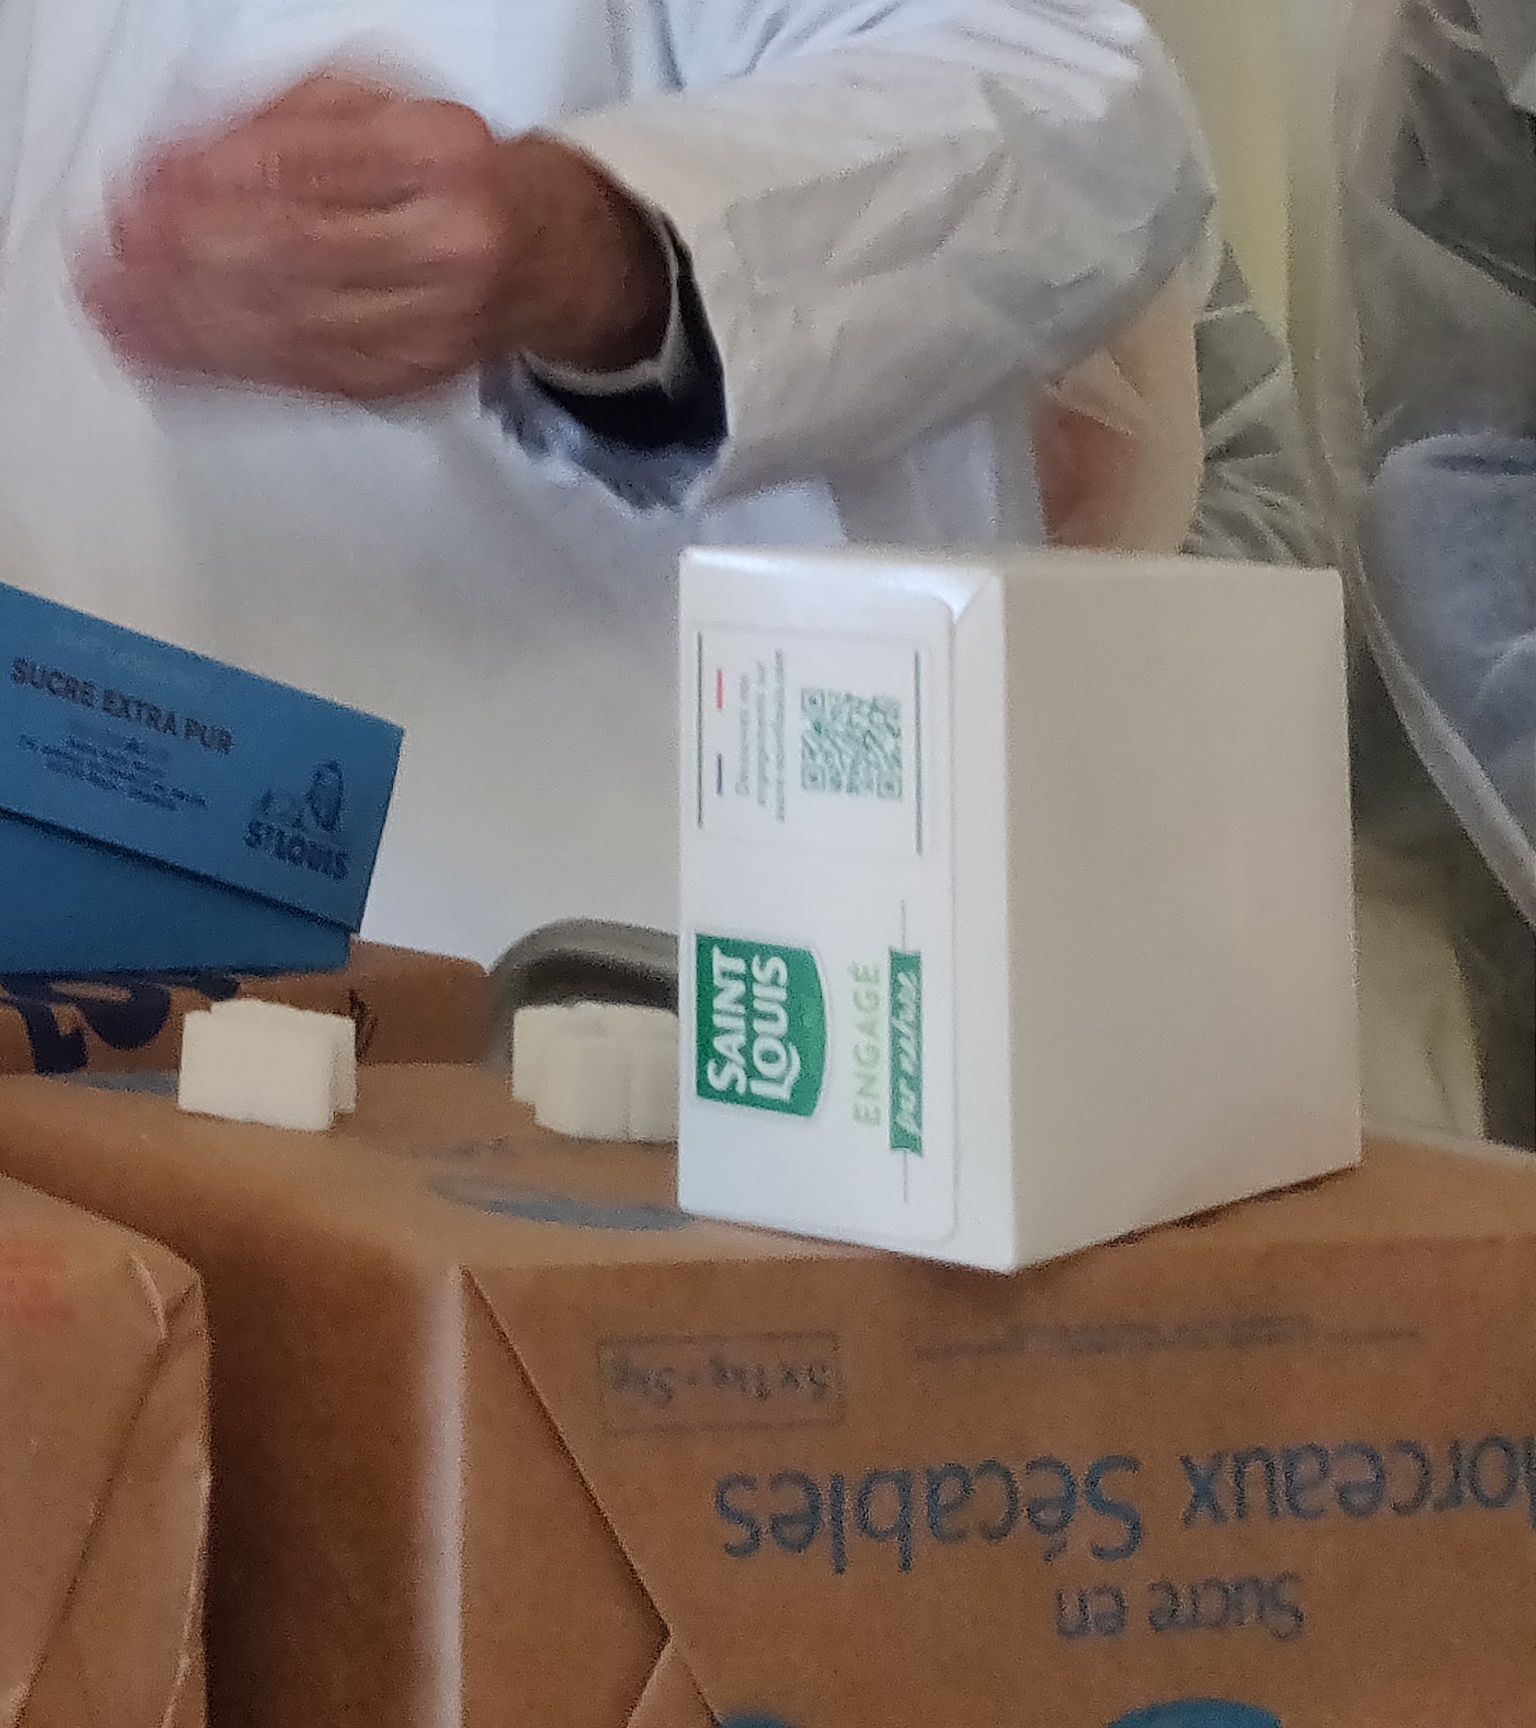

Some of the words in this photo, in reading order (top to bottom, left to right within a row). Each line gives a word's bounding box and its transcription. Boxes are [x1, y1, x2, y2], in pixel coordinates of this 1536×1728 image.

[11, 657, 95, 709] SUCRE
[102, 688, 177, 737] EXTRA
[184, 717, 233, 757] PUR
[707, 944, 747, 1096] SAINT
[750, 954, 802, 1104] LOUIS
[713, 1454, 1145, 1575] Sécables
[1179, 1434, 1536, 1532] orceaux
[1055, 1583, 1128, 1641] en
[1147, 1574, 1305, 1643] Sucre
